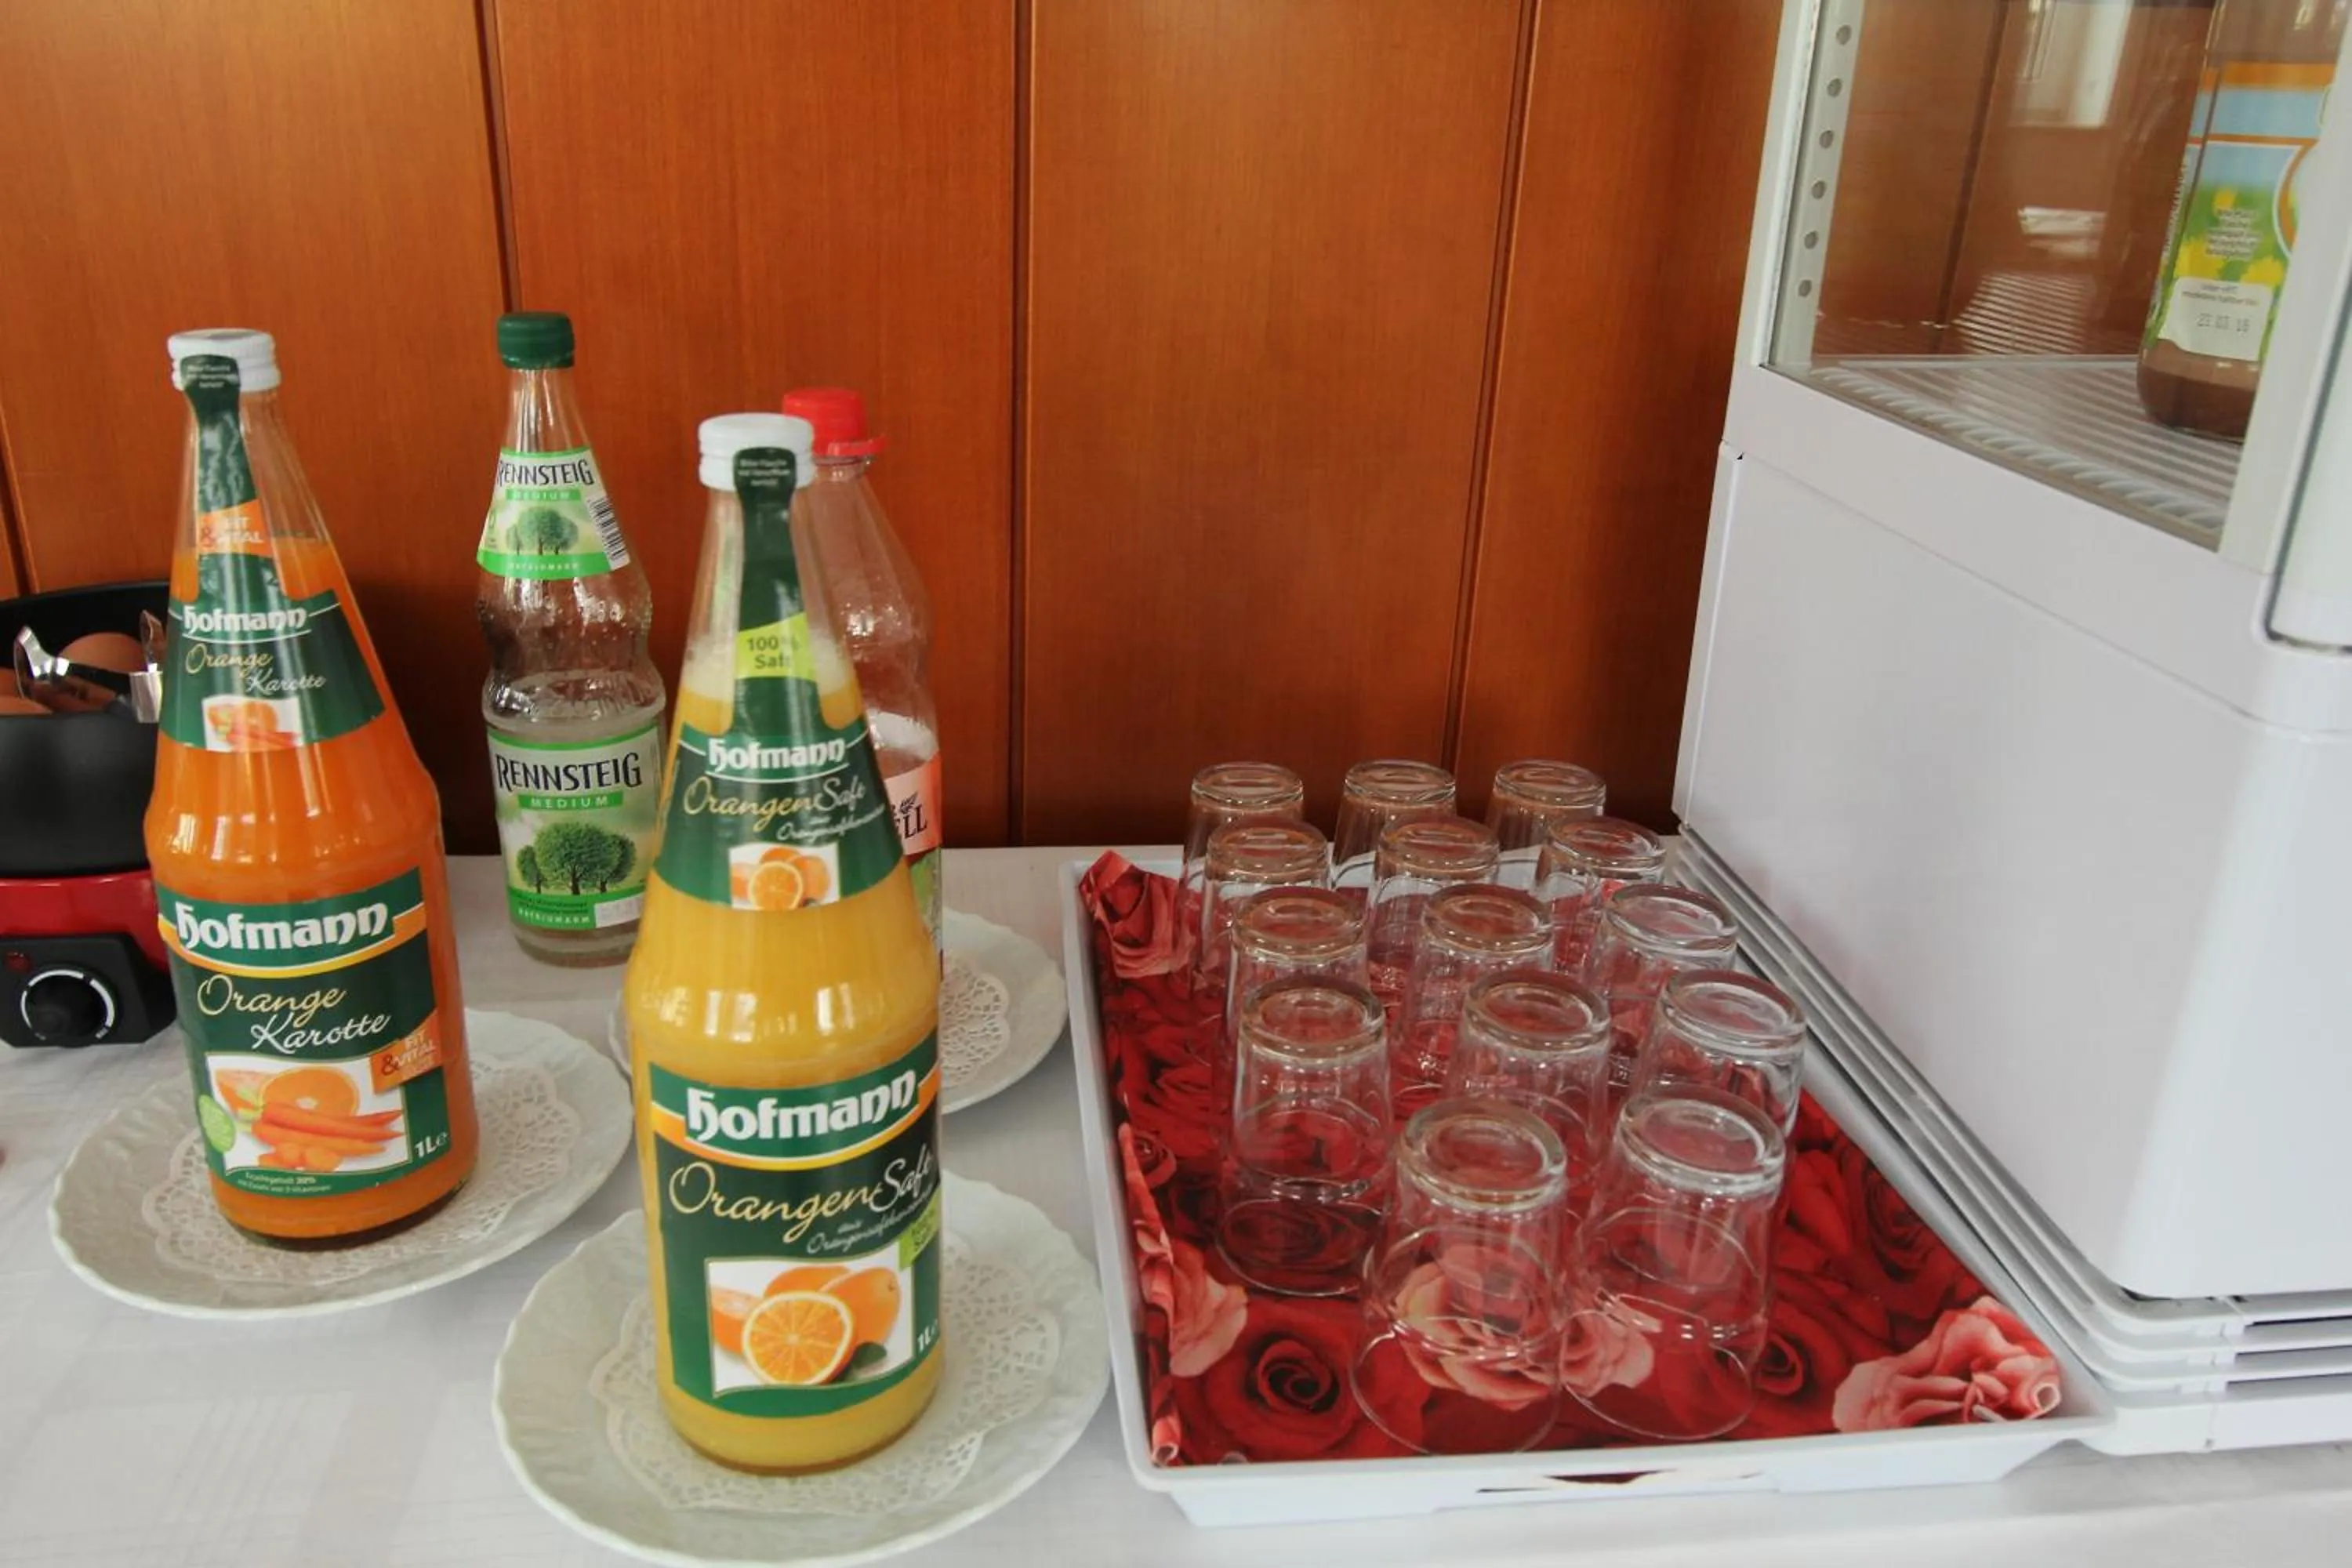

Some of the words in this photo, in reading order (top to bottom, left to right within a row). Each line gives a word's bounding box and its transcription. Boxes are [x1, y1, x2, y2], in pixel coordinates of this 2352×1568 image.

[498, 459, 594, 487] RENNSTEIG
[185, 642, 274, 679] Orange
[245, 666, 326, 694] Karotte
[495, 752, 642, 792] RENNSTEIG
[531, 796, 608, 808] MEDIUM
[197, 974, 347, 1028] Orange
[250, 1012, 390, 1054] Karotte
